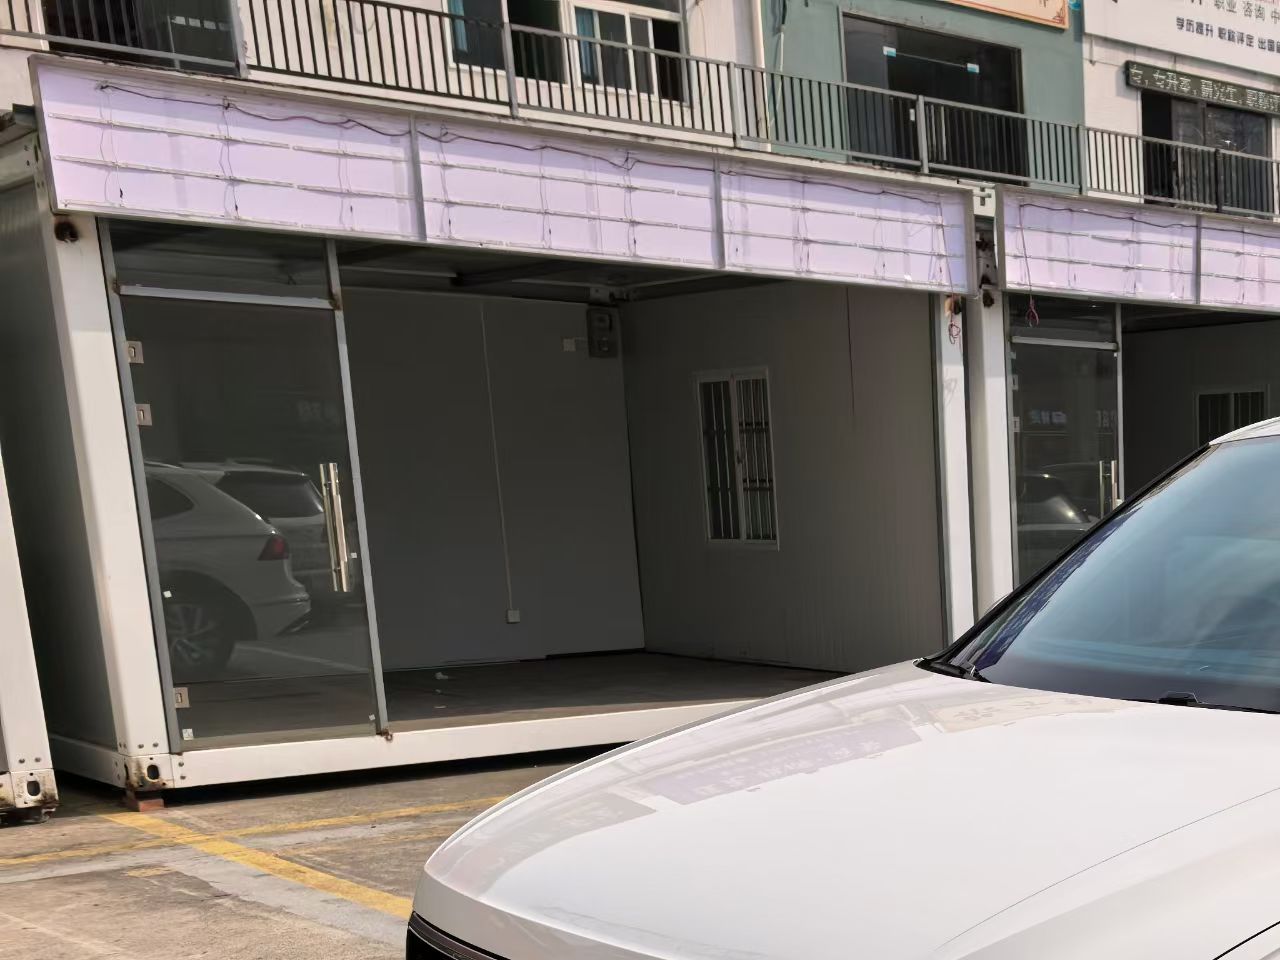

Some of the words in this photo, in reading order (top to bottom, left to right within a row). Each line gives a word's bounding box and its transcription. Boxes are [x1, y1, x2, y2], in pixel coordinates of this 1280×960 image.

[1176, 16, 1214, 38] 学历提升
[1217, 26, 1255, 48] 职称评定
